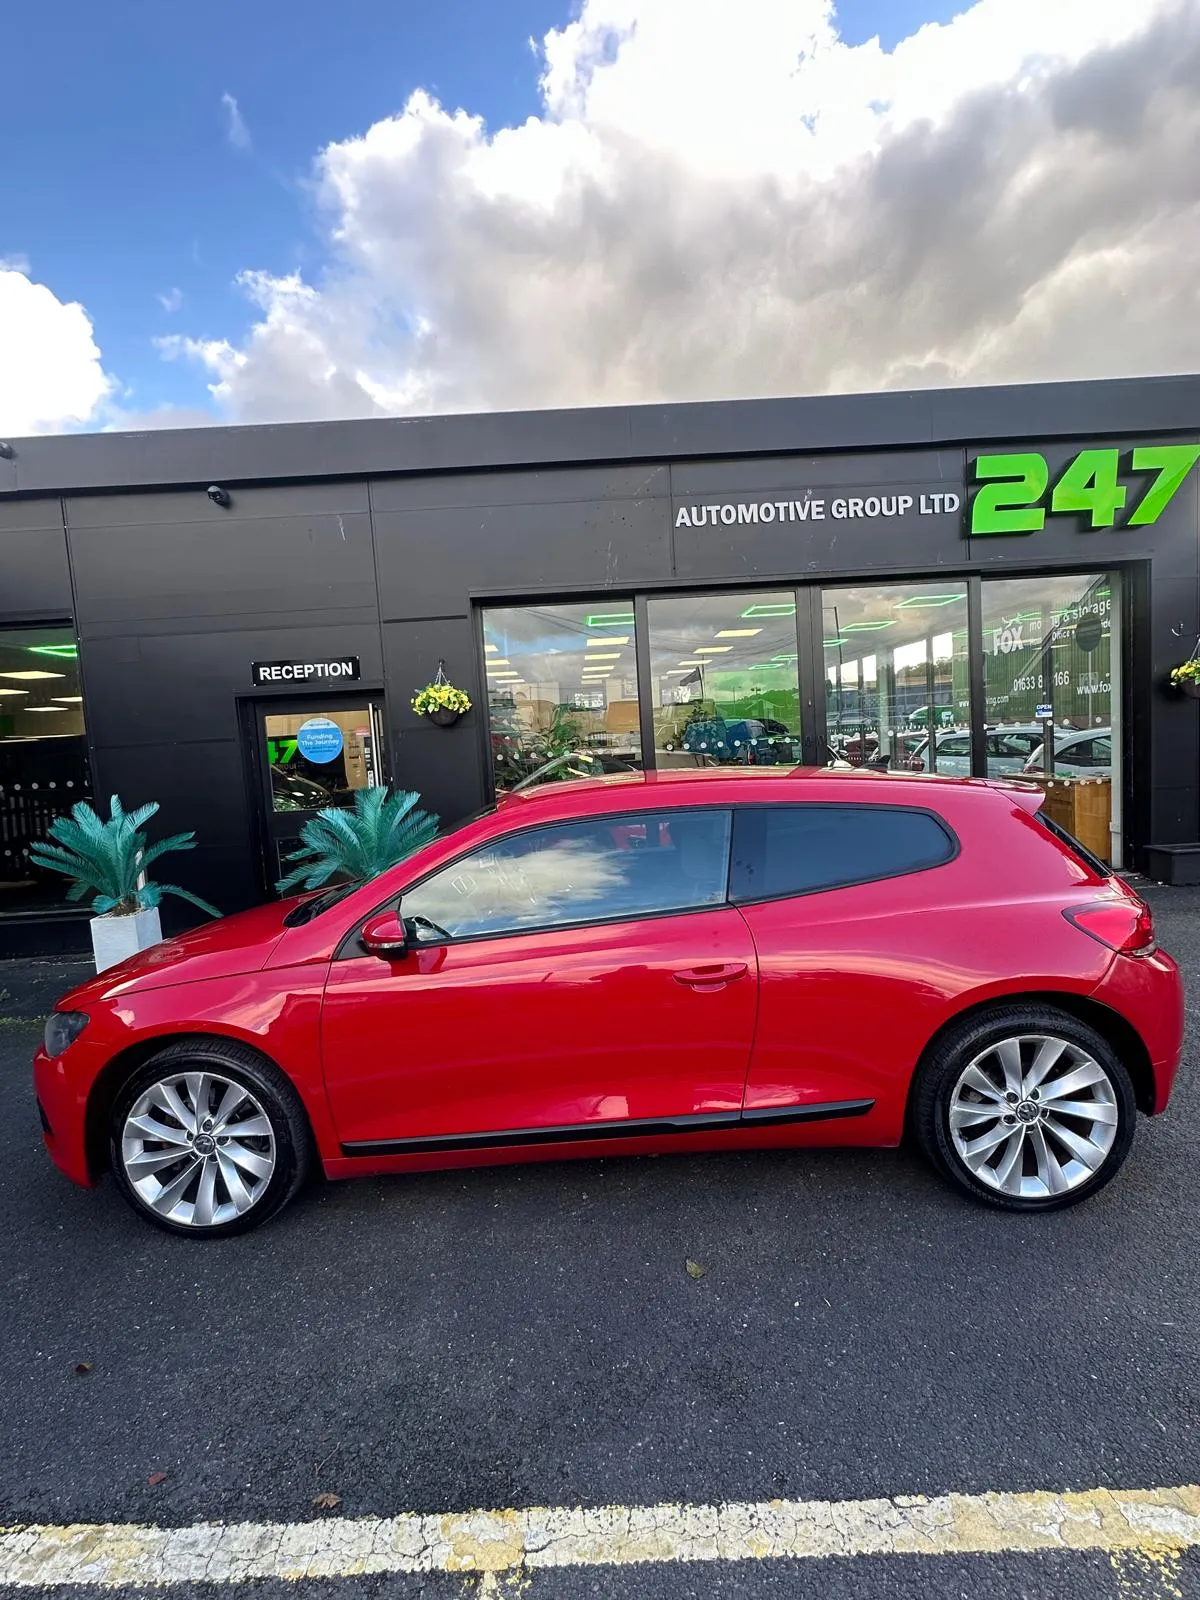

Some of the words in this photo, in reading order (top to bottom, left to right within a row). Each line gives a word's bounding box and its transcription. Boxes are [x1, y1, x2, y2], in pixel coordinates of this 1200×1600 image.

[971, 445, 1200, 534] 247
[675, 499, 826, 528] AUTOMOTIVE
[831, 495, 914, 519] GROUP
[919, 493, 961, 514] LTD
[1072, 599, 1110, 619] storage
[994, 624, 1024, 656] FOX
[259, 662, 353, 681] RECEPTION
[1014, 677, 1036, 692] 01633
[301, 739, 314, 747] The
[315, 738, 340, 746] Journey
[306, 732, 334, 741] Funding
